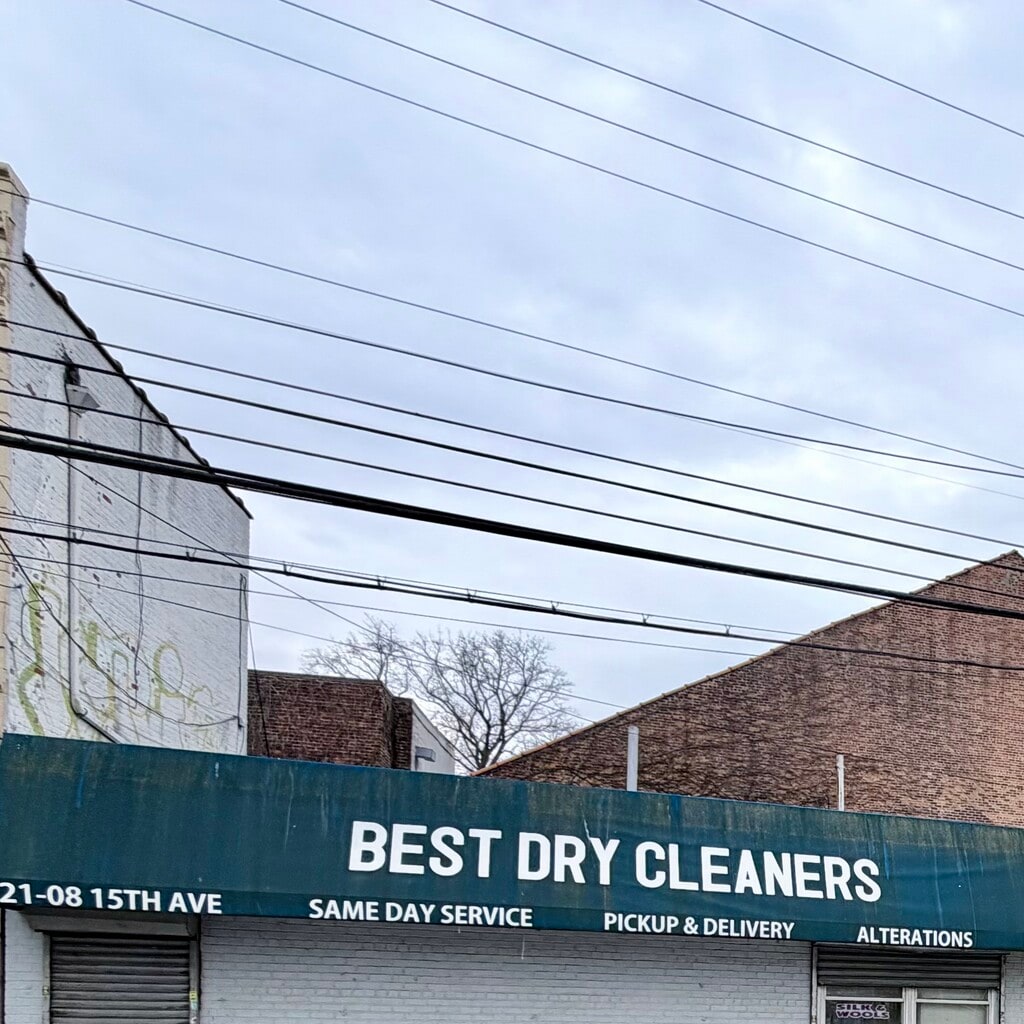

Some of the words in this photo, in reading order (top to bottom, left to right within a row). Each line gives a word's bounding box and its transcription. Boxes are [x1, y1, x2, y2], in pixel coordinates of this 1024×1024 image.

[348, 820, 502, 878] BEST
[517, 832, 621, 886] DRY
[635, 841, 882, 903] CLEANERS
[0, 881, 83, 908] 21-08
[90, 888, 161, 912] 15TH
[168, 892, 223, 915] AVE
[308, 898, 380, 921] SAME
[385, 902, 437, 923] DAY
[440, 904, 534, 928] SERVICE
[603, 912, 680, 934] PICKUP
[683, 916, 700, 935] &
[703, 917, 796, 939] DELIVERY
[856, 926, 974, 948] ALTERATIONS
[836, 1003, 873, 1011] SILK
[836, 1011, 890, 1019] WOOLS
